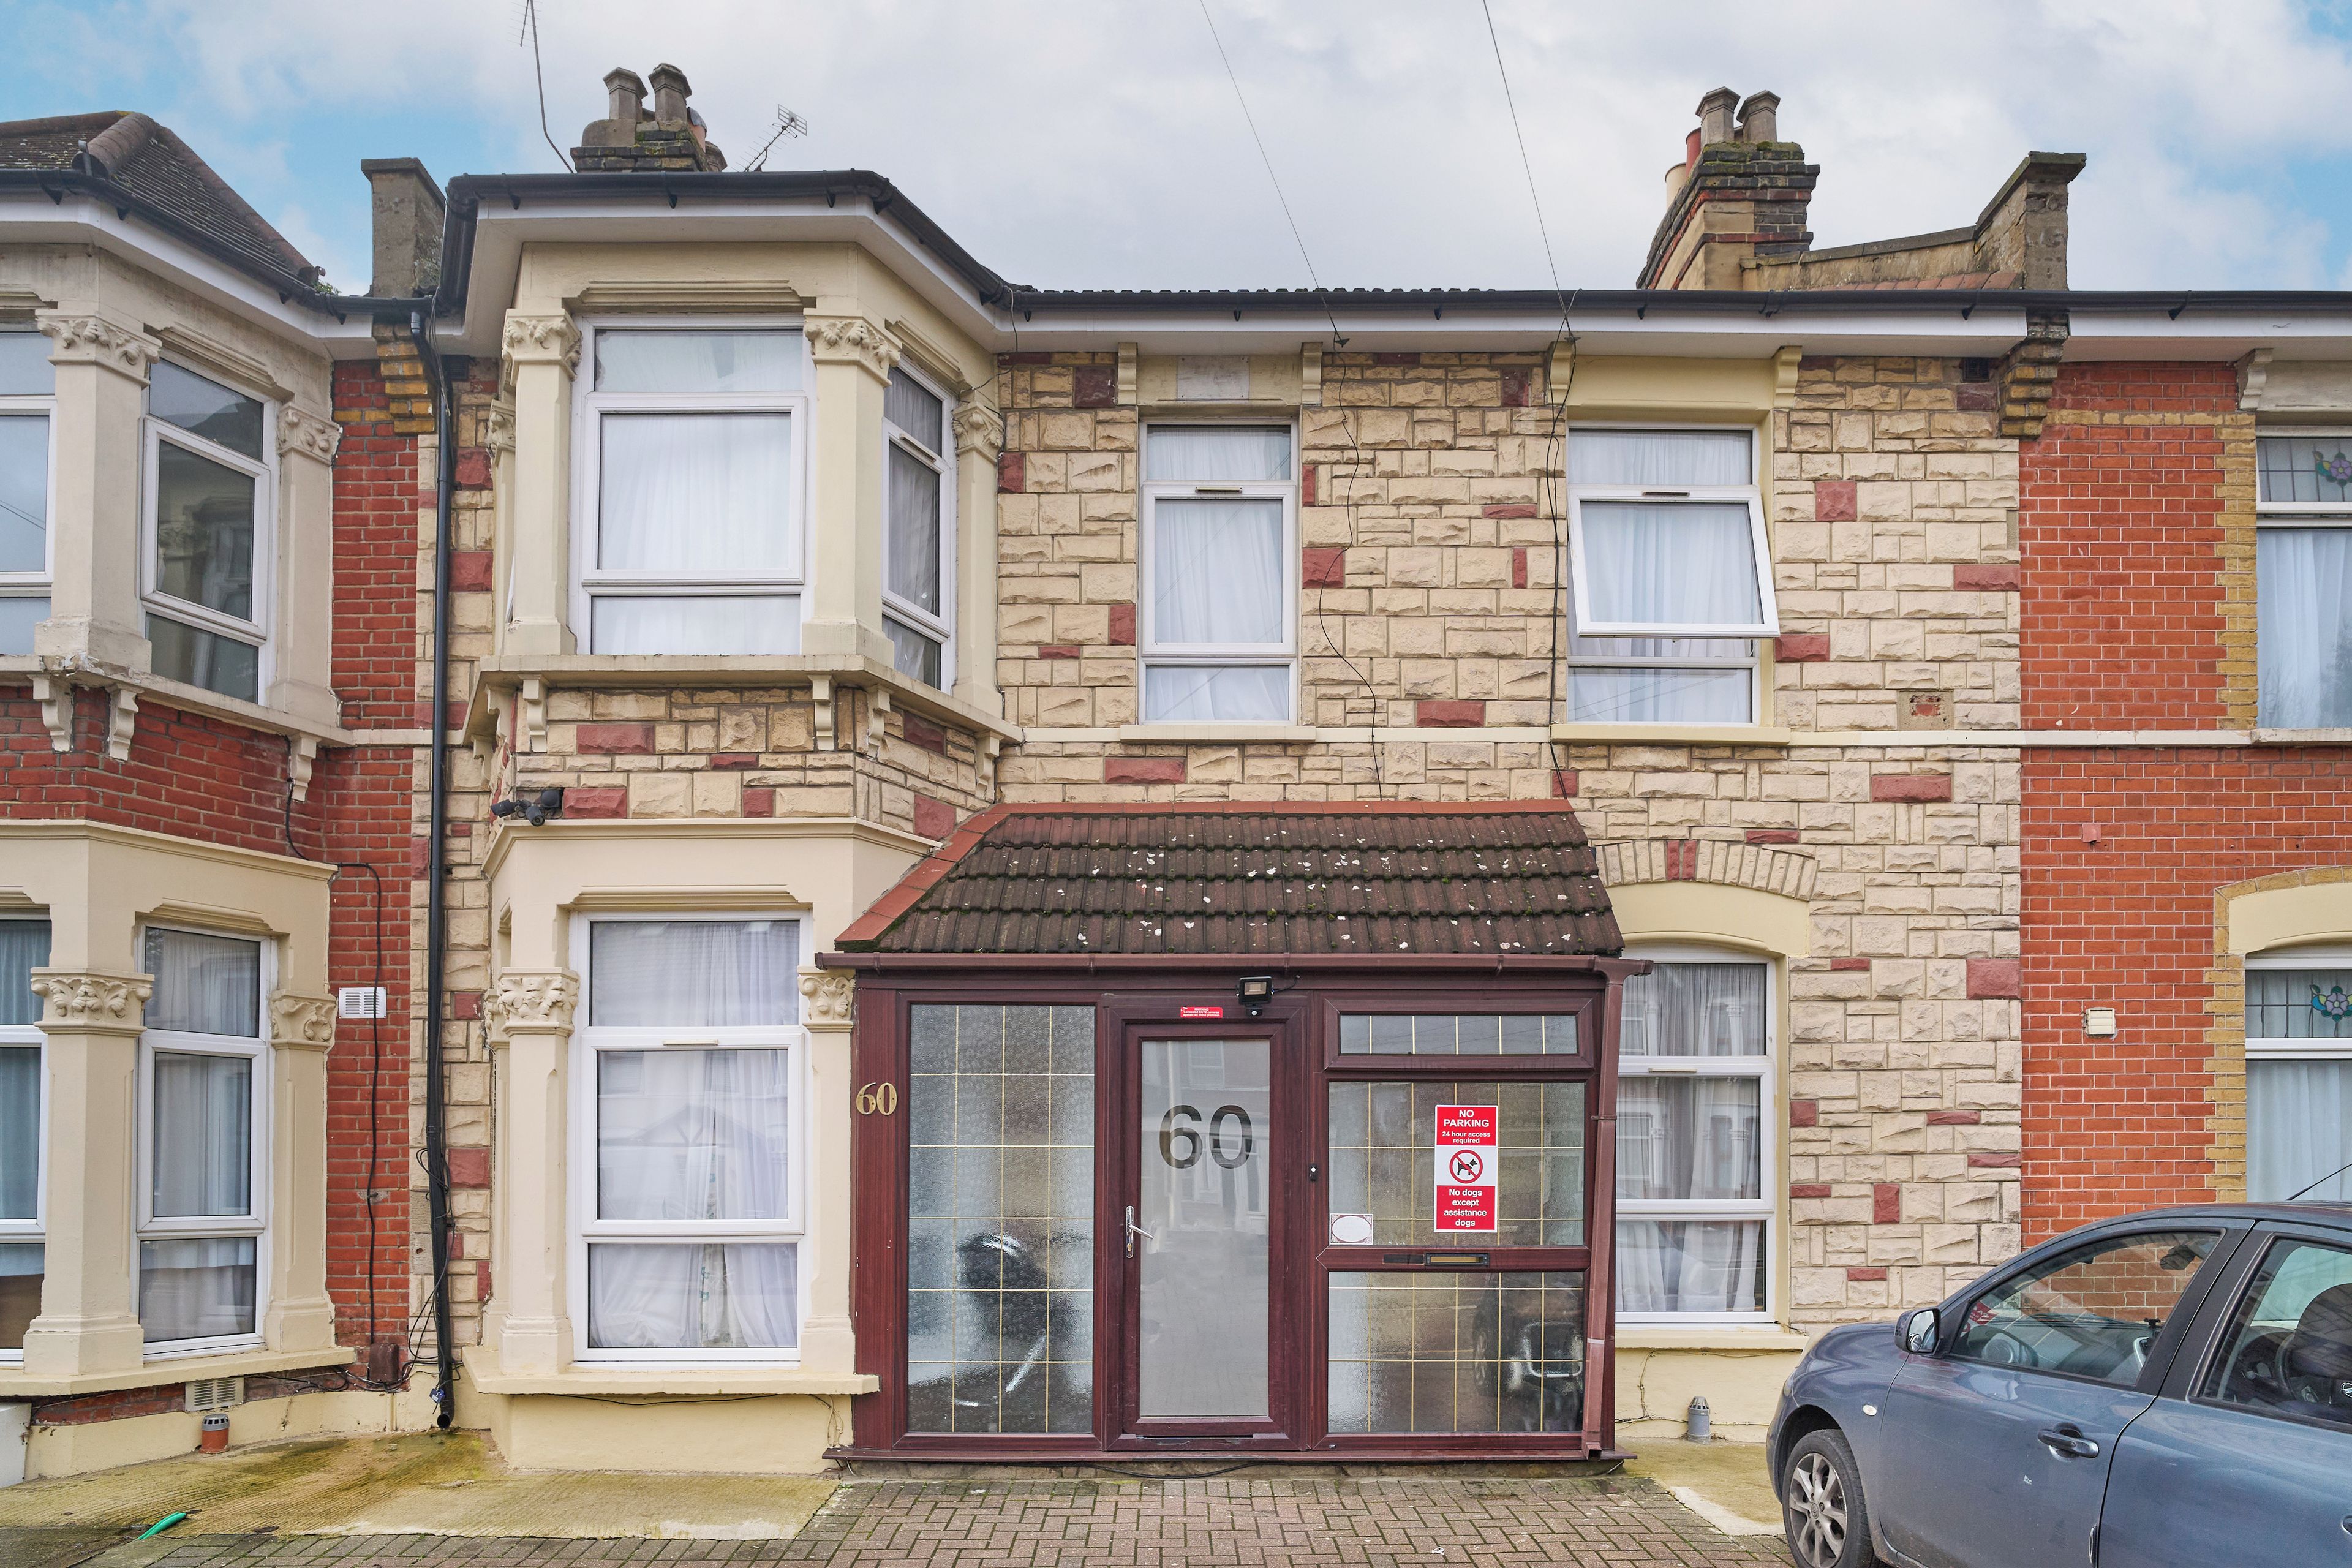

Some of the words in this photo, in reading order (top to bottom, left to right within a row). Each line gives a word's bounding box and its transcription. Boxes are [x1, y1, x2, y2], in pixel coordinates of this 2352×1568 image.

[856, 1082, 897, 1115] 60
[1459, 1109, 1474, 1118] NO
[1159, 1104, 1253, 1169] 60
[1462, 1189, 1483, 1197] dogs
[1455, 1219, 1476, 1227] dogs
